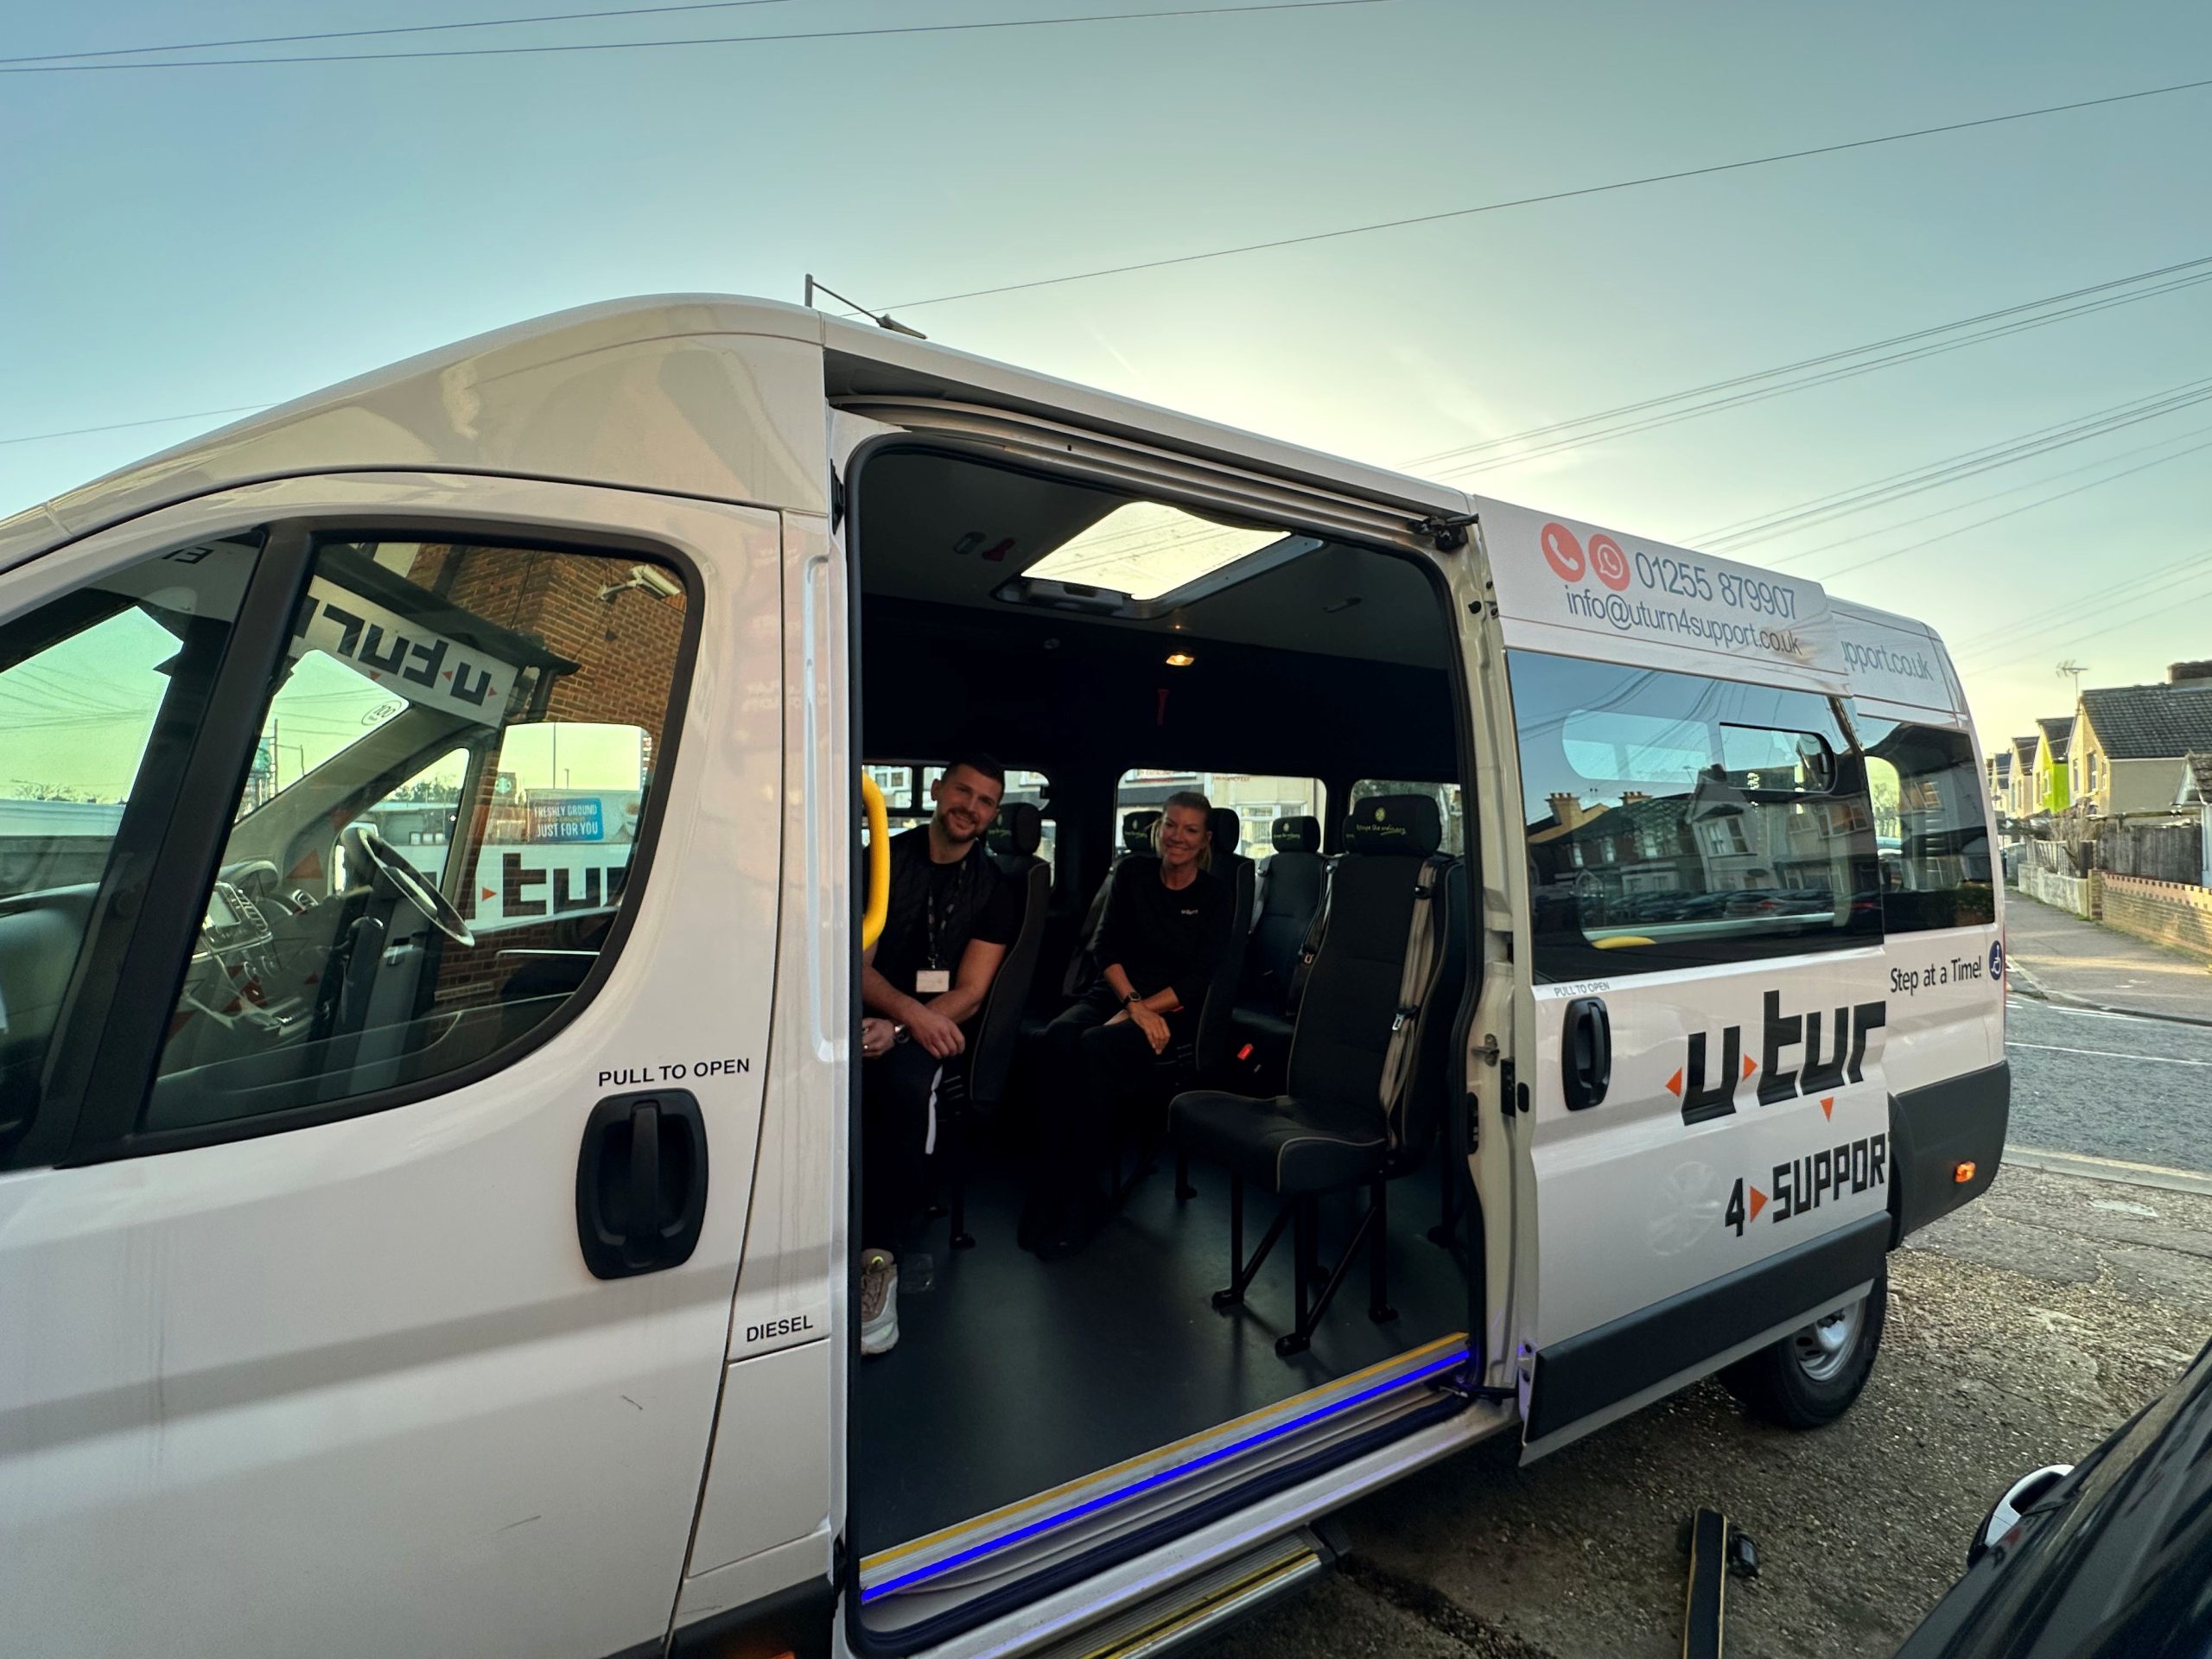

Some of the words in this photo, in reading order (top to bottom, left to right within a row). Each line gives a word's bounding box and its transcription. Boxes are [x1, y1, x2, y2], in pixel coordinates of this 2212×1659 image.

[1635, 551, 1713, 601] 01255
[1718, 572, 1797, 620] 879907
[1565, 585, 1803, 655] info@uturn4support.co.uk
[567, 804, 598, 816] GROUND
[537, 823, 559, 837] JUST
[560, 822, 578, 836] FOR
[580, 821, 599, 836] YOU
[1554, 987, 1576, 997] PULL
[1576, 984, 1587, 994] TO
[1587, 982, 1611, 993] OPEN
[1890, 967, 1919, 996] Step
[1923, 963, 1936, 987] at
[1940, 966, 1948, 984] a
[1951, 955, 1982, 982] Time!
[598, 1067, 655, 1087] PULL
[658, 1064, 687, 1080] TO
[693, 1058, 750, 1077] OPEN
[1725, 1177, 1745, 1238] 4
[747, 1314, 814, 1343] DIESEL
